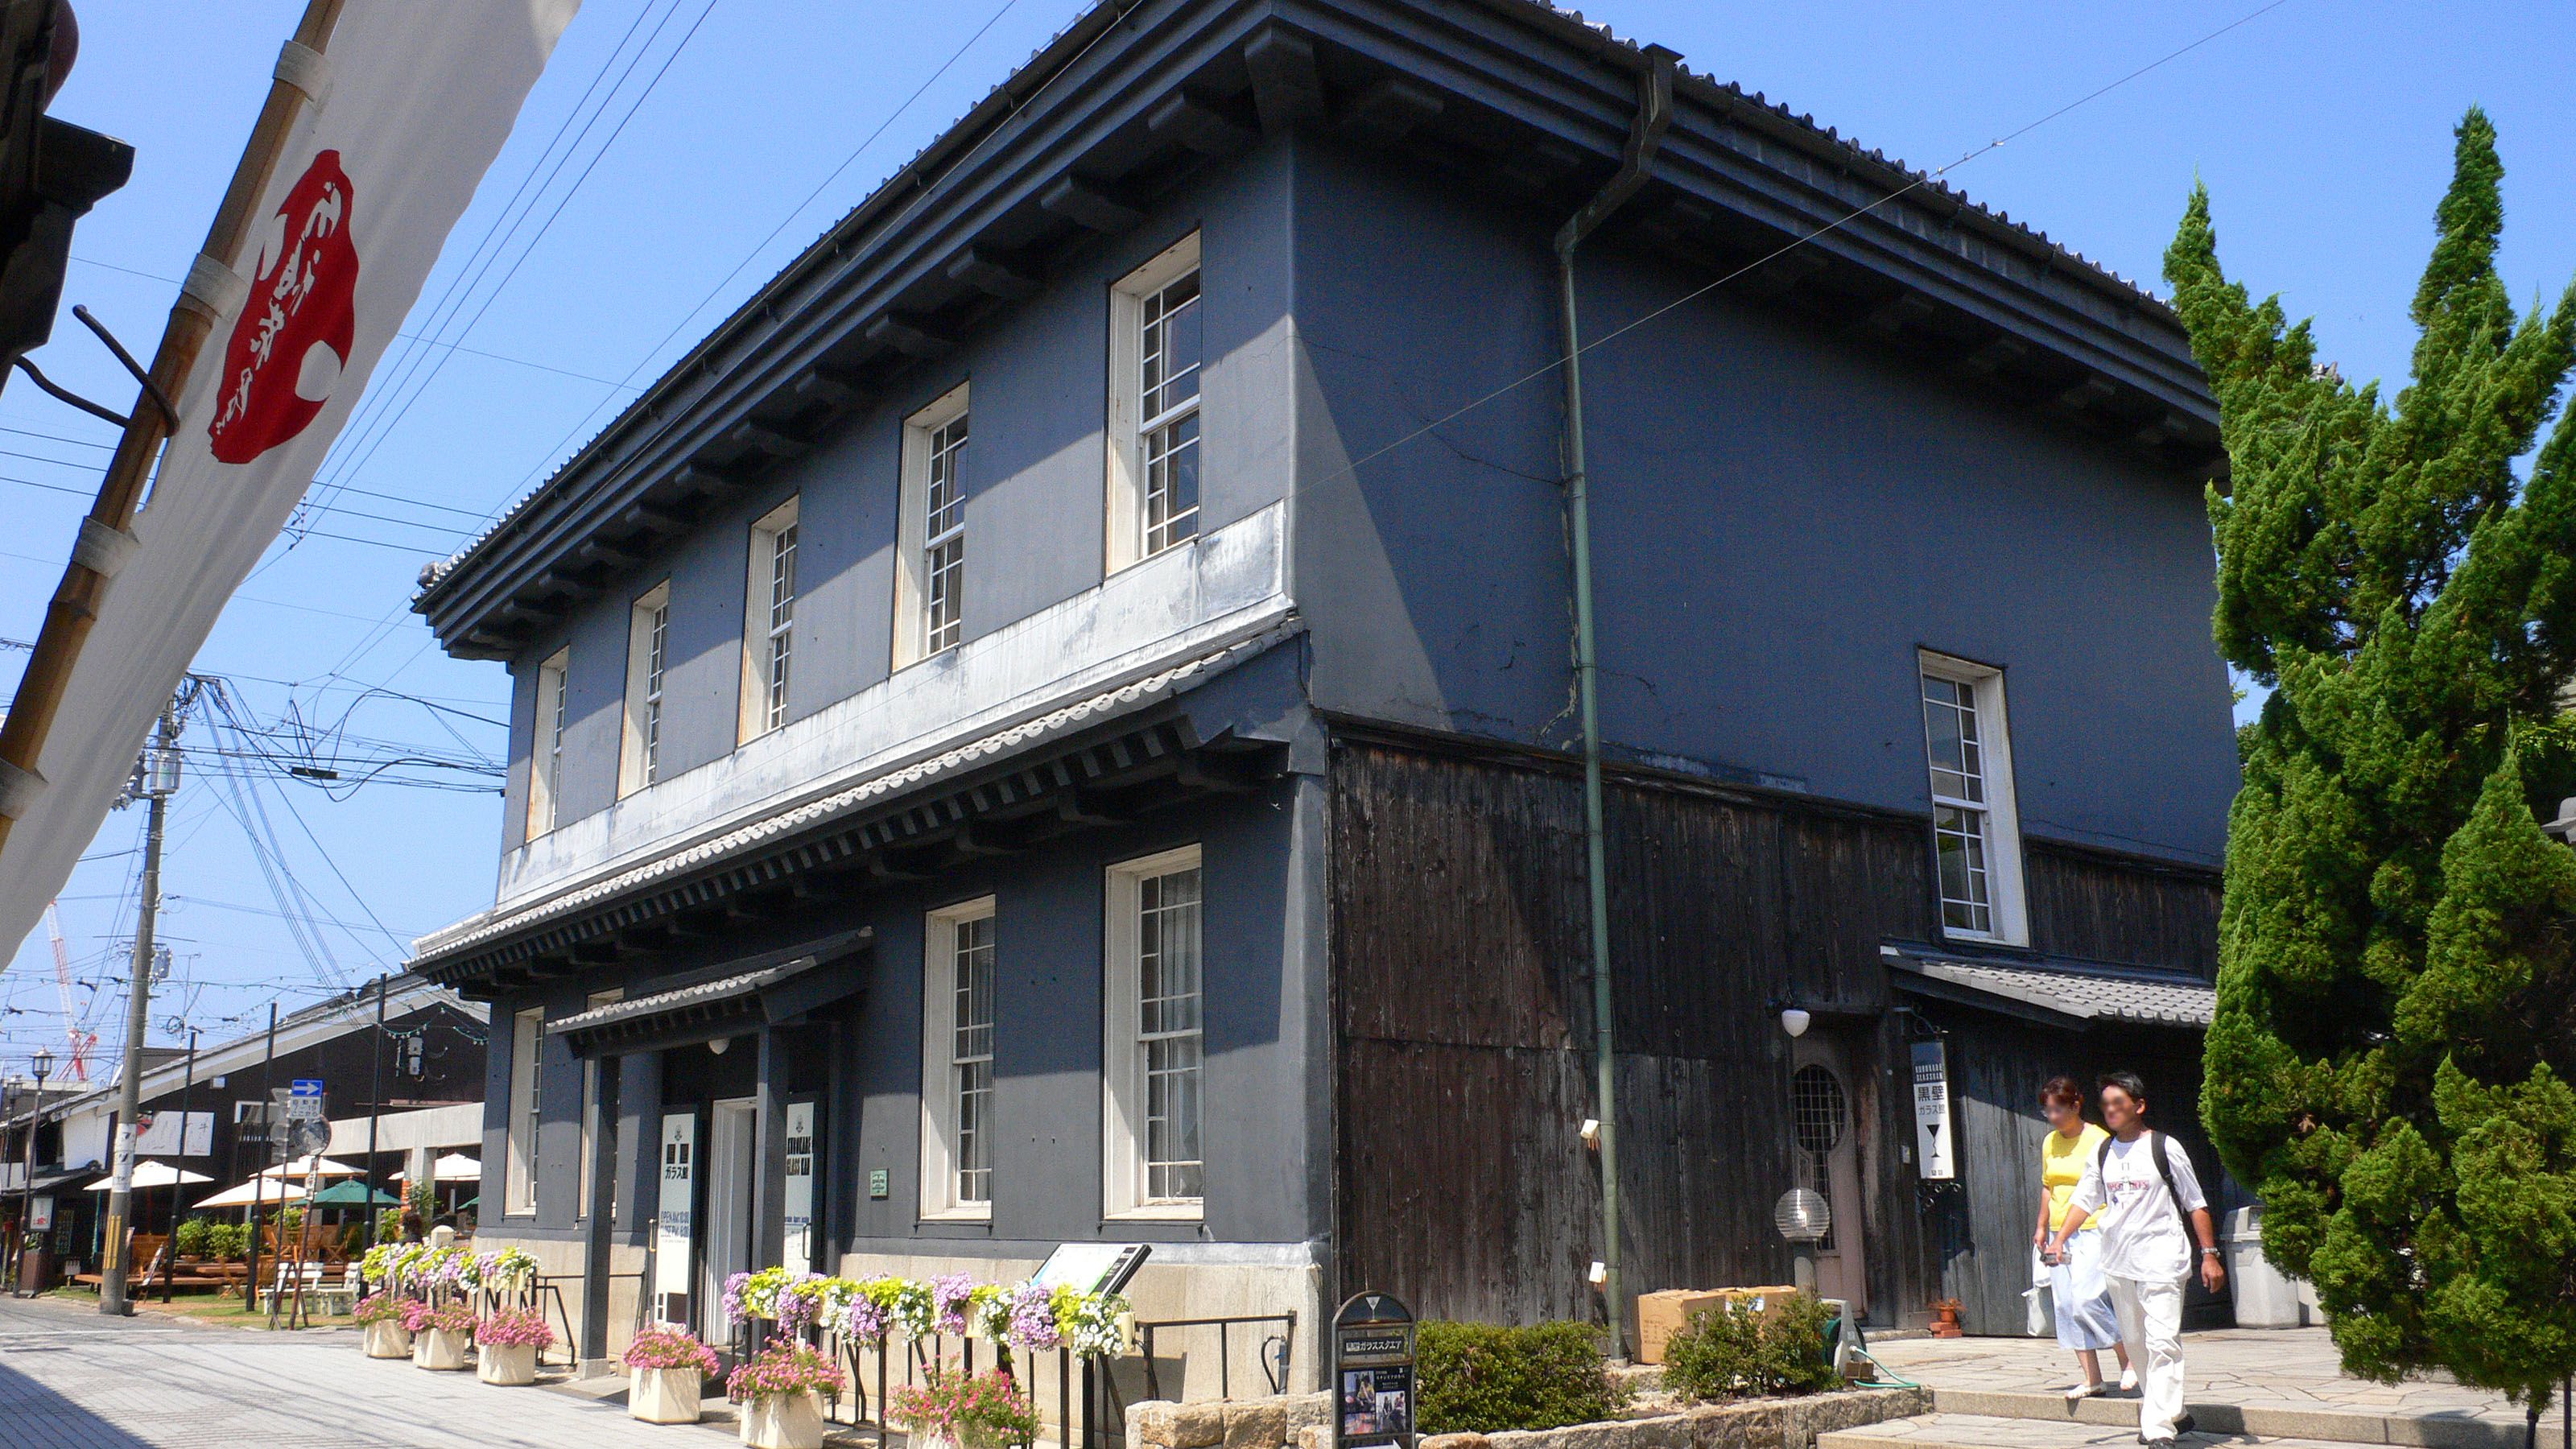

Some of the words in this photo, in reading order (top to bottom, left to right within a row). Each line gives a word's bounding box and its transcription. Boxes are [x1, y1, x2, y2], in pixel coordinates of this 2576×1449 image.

[1918, 1085, 1944, 1101] 黒壁
[1918, 1104, 1946, 1116] ガラス館
